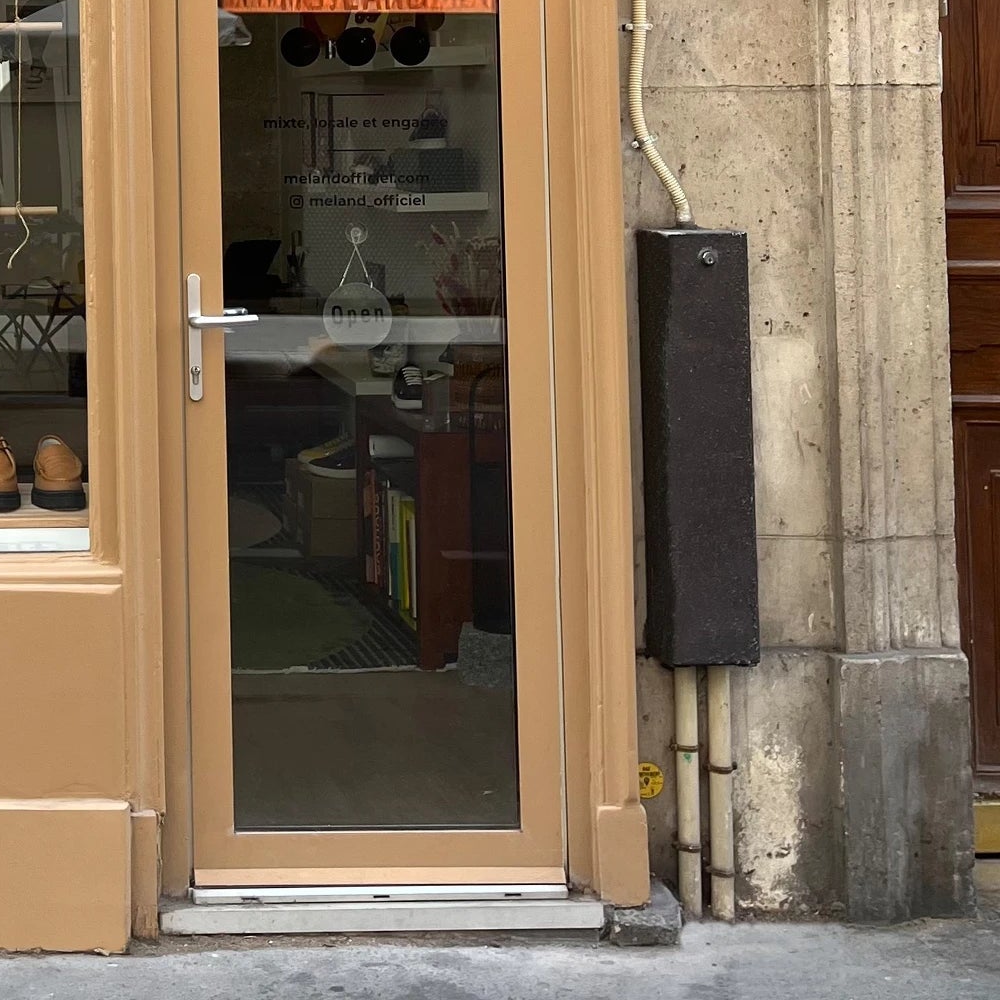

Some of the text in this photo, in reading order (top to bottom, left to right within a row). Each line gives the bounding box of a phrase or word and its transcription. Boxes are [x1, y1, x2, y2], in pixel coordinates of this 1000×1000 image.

[263, 116, 310, 130] mixte,
[362, 117, 377, 128] et
[309, 194, 426, 208] meland_officiel
[331, 305, 384, 328] Open
